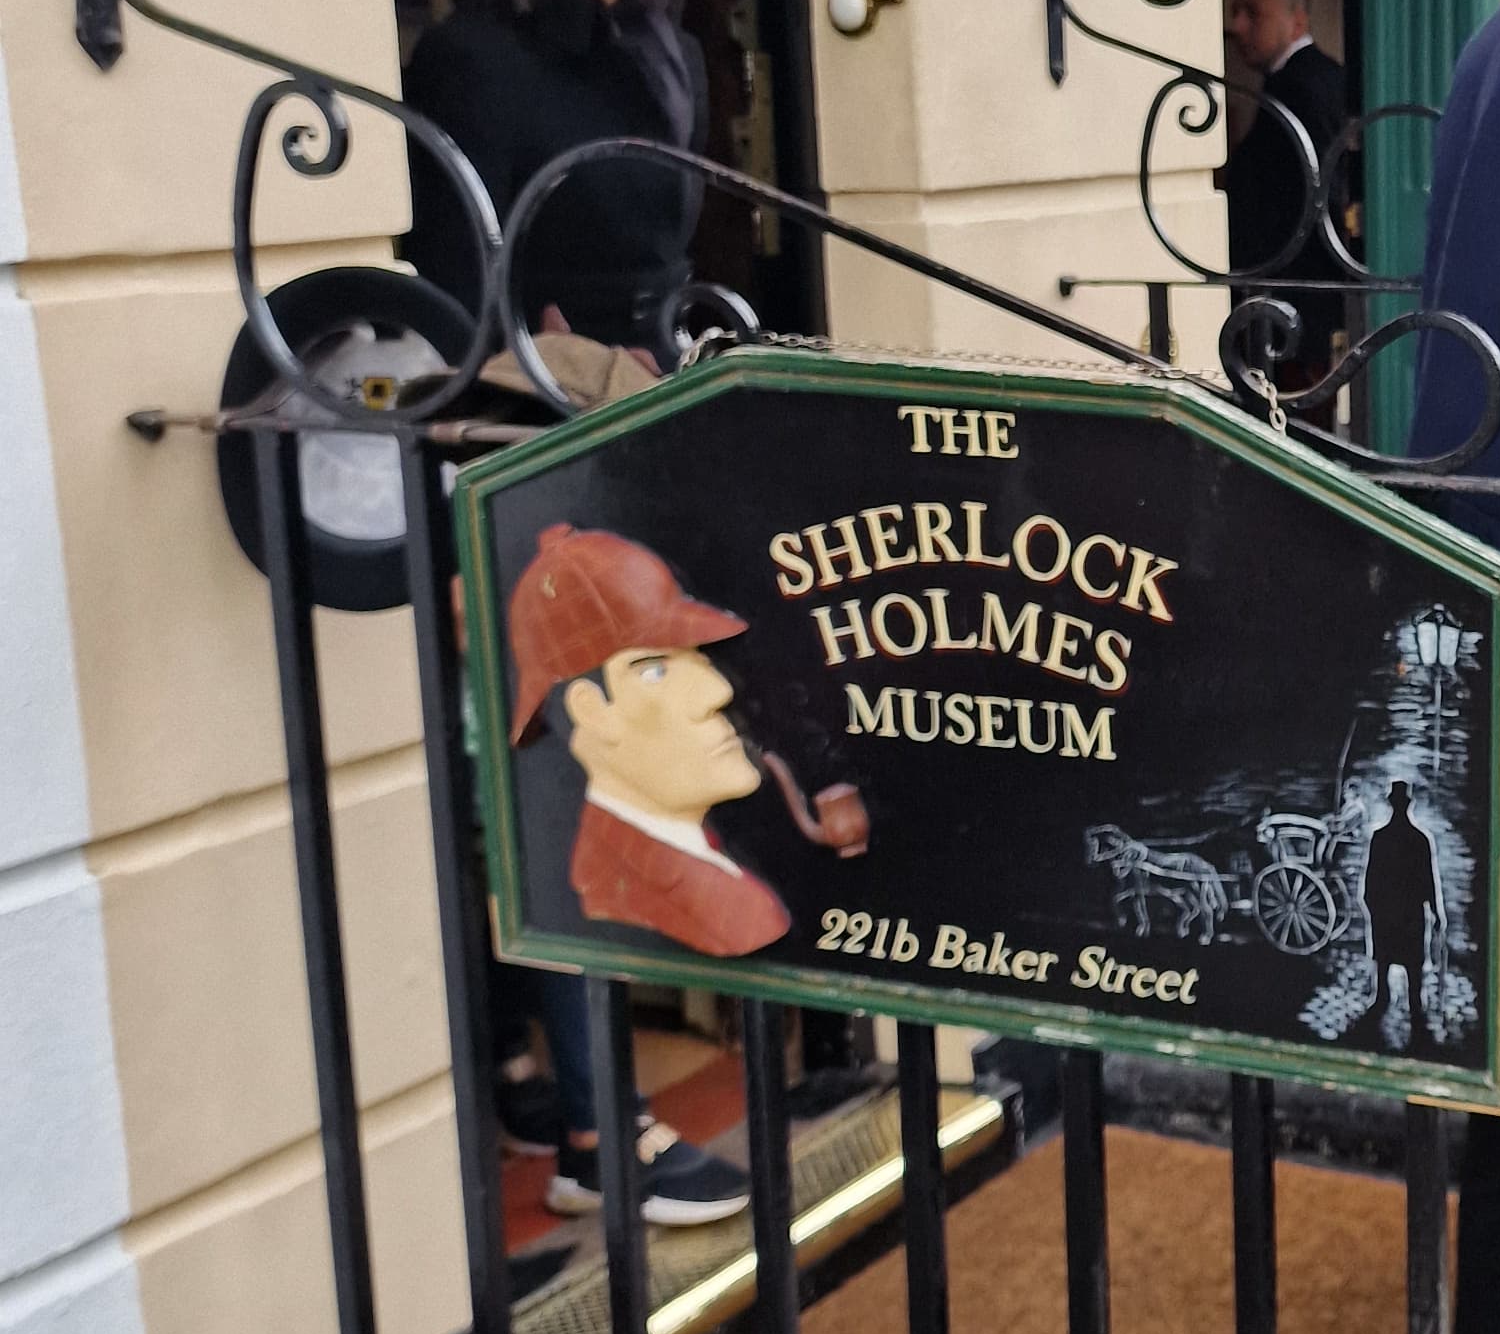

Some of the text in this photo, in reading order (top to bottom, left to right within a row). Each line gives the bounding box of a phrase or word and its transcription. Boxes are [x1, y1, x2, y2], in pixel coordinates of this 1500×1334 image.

[898, 405, 1020, 459] THE
[769, 500, 1179, 623] SHERLOCK
[810, 588, 1133, 692] HOLMES
[843, 682, 1118, 761] MUSEUM
[816, 908, 1200, 1005] 221b Baker Street
